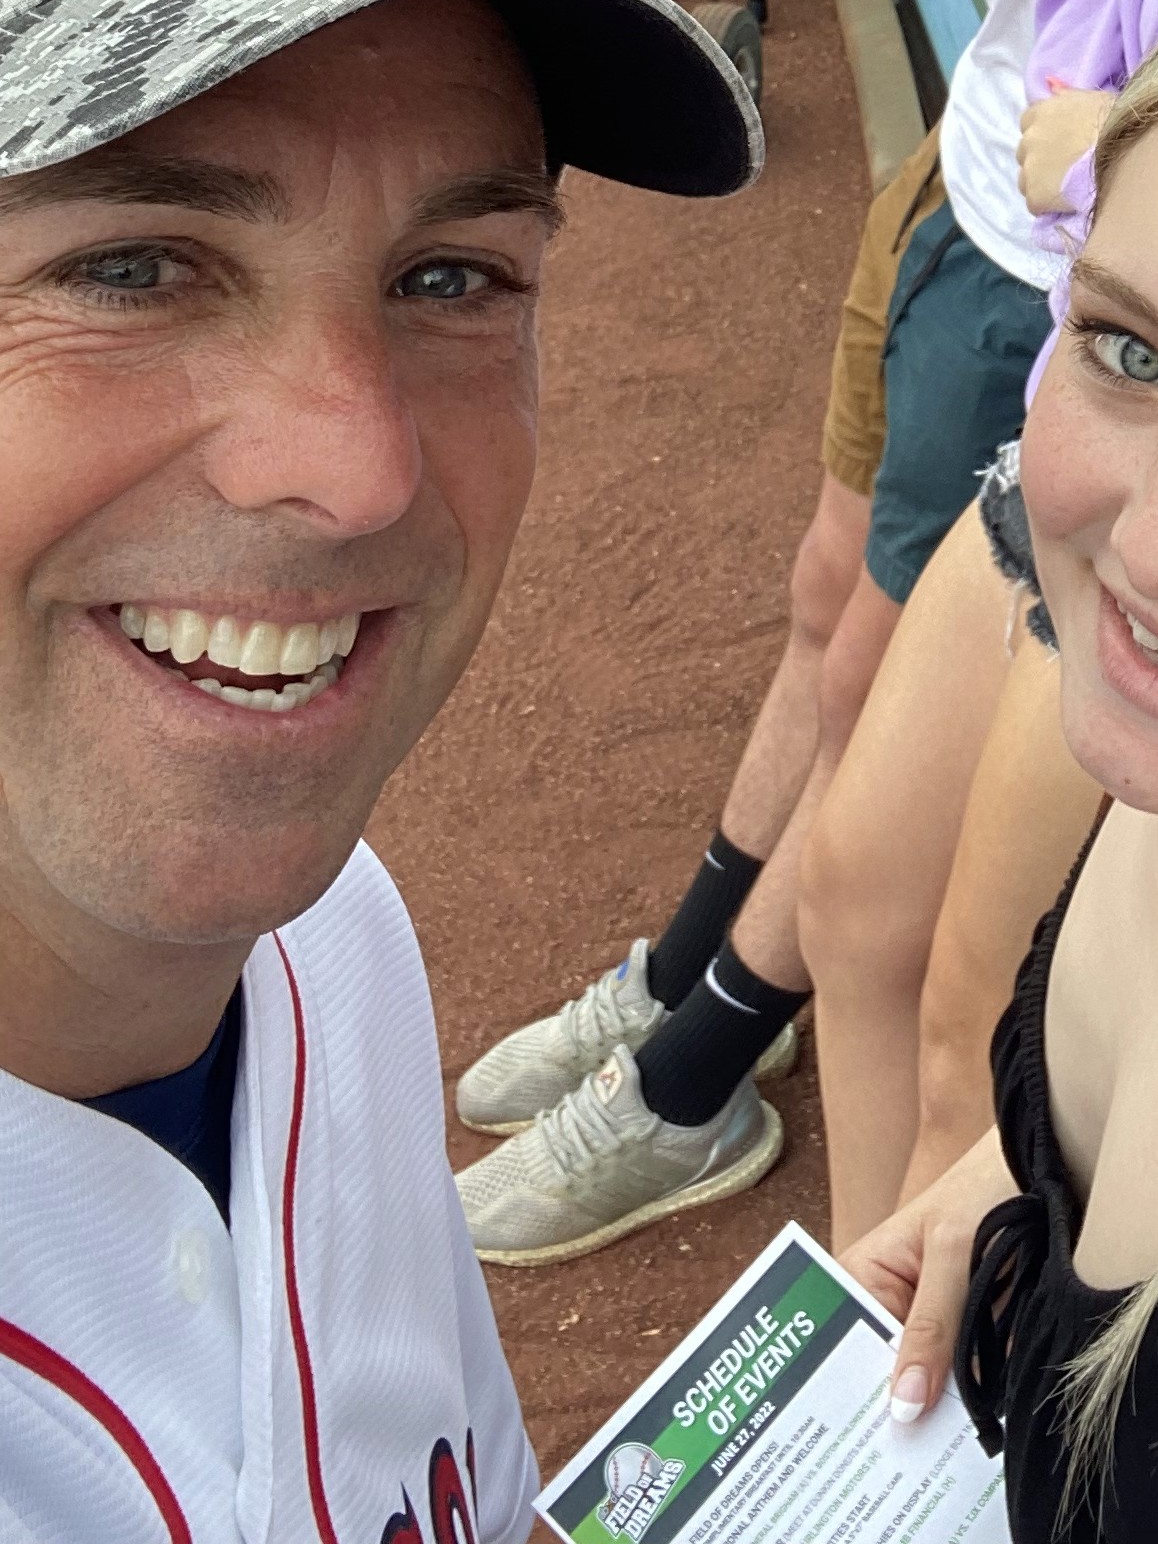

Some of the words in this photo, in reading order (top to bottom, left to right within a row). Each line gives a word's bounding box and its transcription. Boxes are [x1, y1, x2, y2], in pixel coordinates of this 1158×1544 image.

[669, 1304, 780, 1429] SCHEDULE
[705, 1393, 737, 1436] OF
[733, 1309, 816, 1406] EVENTS
[710, 1440, 740, 1477] JUNE
[734, 1426, 755, 1446] 27,
[748, 1400, 776, 1429] 2022
[744, 1461, 776, 1498] BREAKFAST
[774, 1442, 792, 1462] UNTIL
[746, 1481, 780, 1521] ANTHEM
[776, 1463, 795, 1484] AND
[791, 1422, 829, 1466] WELCOME
[815, 1440, 840, 1469] BOSTON
[603, 1483, 644, 1534] FIELD
[623, 1459, 684, 1539] DREAMS
[688, 1518, 713, 1543] FIELD
[709, 1506, 723, 1522] OF
[719, 1470, 753, 1509] DREAMS
[749, 1440, 779, 1473] OPENS!
[839, 1461, 871, 1500] MOTORS
[846, 1493, 871, 1524] START
[861, 1488, 890, 1523] BASEBALL
[892, 1510, 907, 1527] ON
[903, 1476, 933, 1513] DISPLAY
[949, 1432, 965, 1451] BOX
[908, 1487, 945, 1536] FINANCIAL
[941, 1474, 956, 1492] (H)
